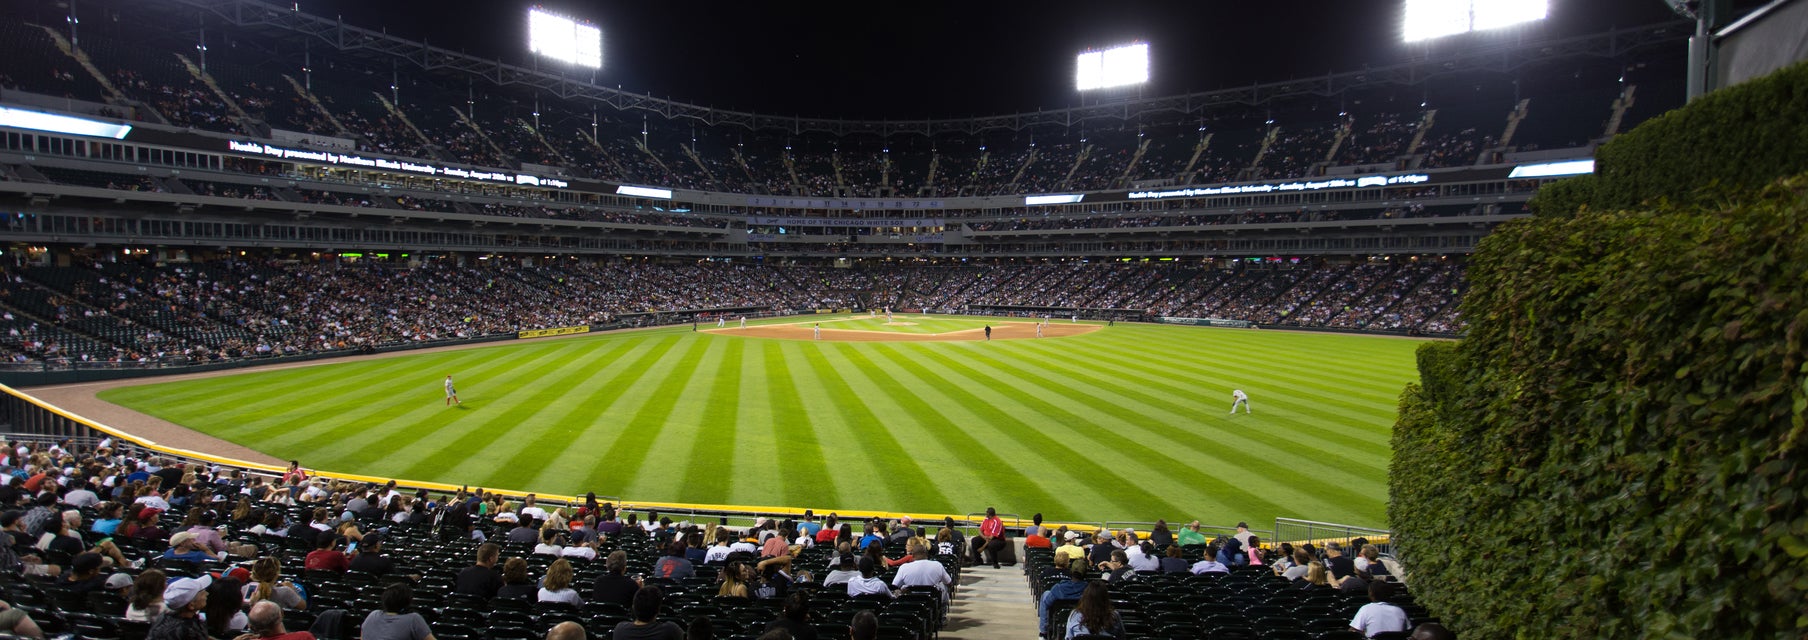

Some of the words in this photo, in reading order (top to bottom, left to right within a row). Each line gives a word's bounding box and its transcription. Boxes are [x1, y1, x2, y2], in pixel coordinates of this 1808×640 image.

[230, 140, 263, 154] Huskie
[264, 145, 284, 157] Day
[284, 149, 327, 161] presented
[327, 152, 339, 164] by
[339, 154, 375, 167] Northern
[375, 158, 401, 170] Illinois
[401, 162, 436, 175] University
[470, 170, 492, 180] August
[1147, 191, 1159, 199] Day
[1186, 188, 1195, 197] by
[1194, 187, 1221, 196] Northern
[1241, 184, 1273, 193] University
